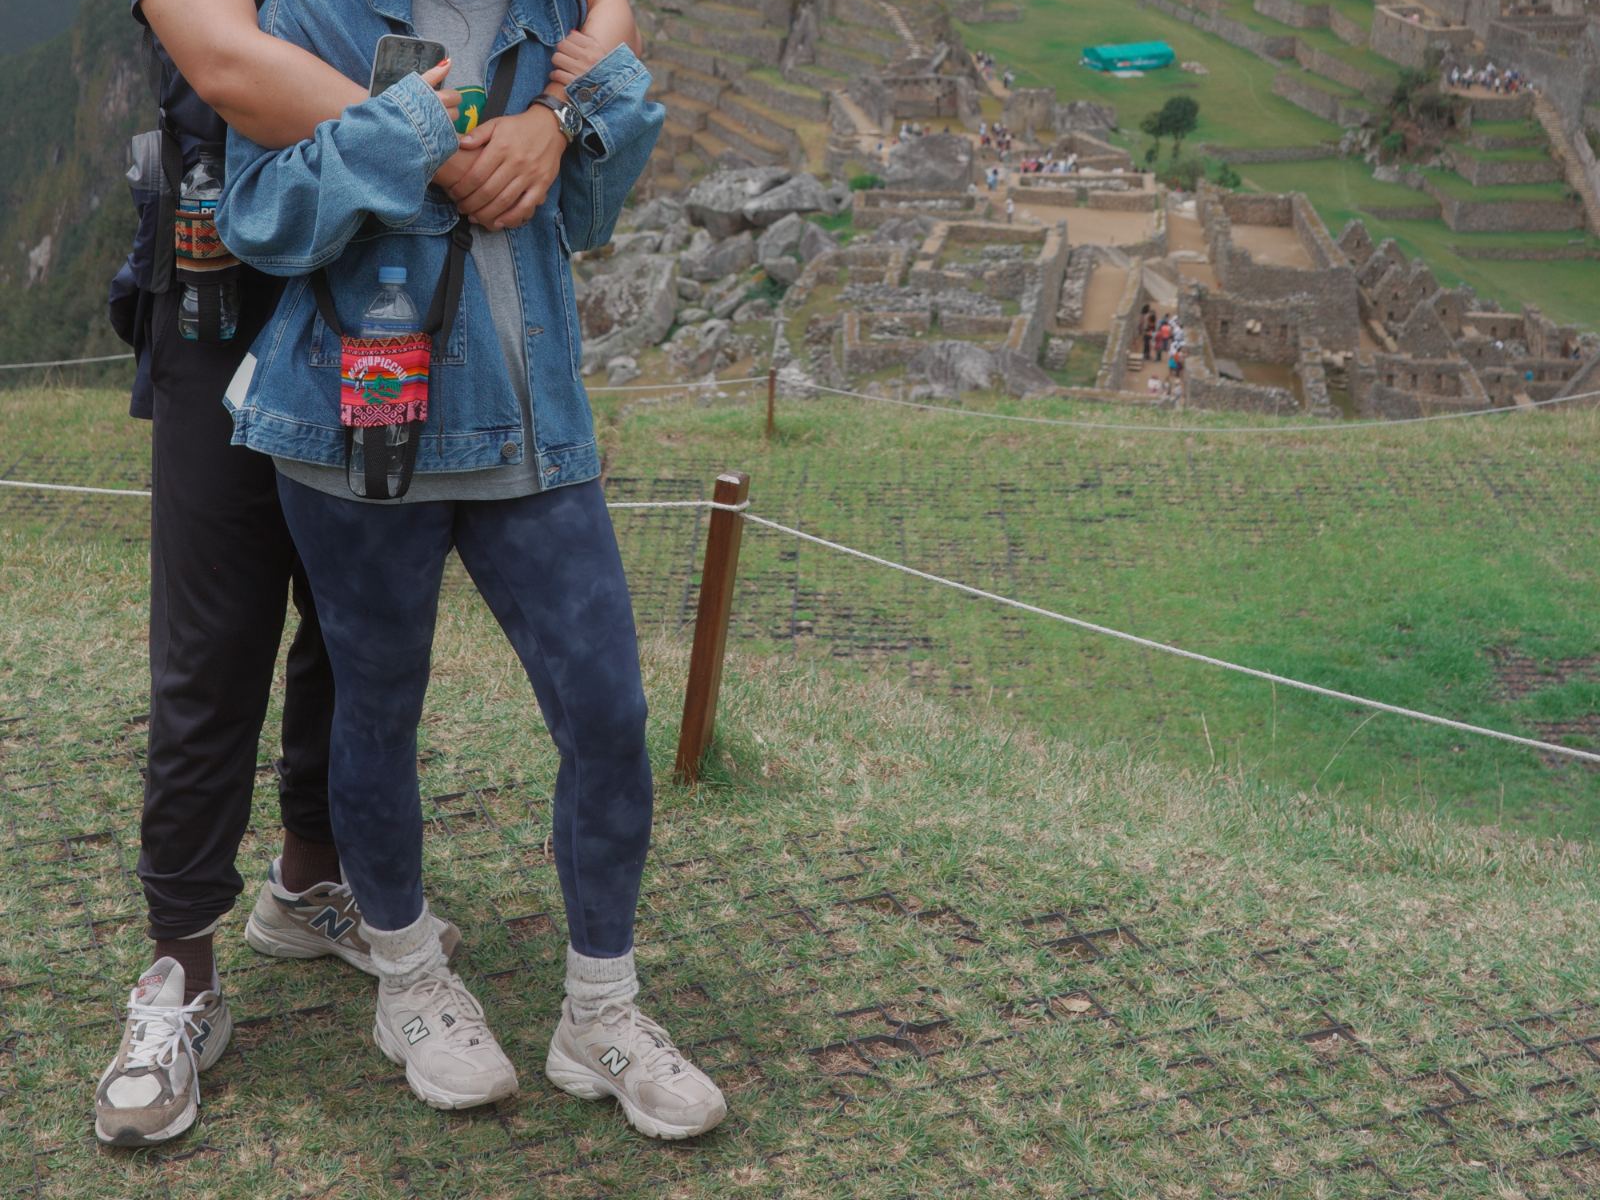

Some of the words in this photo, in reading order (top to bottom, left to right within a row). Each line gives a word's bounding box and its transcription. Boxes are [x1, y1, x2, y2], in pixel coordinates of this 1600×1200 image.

[307, 905, 356, 942] N
[401, 1015, 430, 1046] N
[599, 1046, 631, 1077] N
